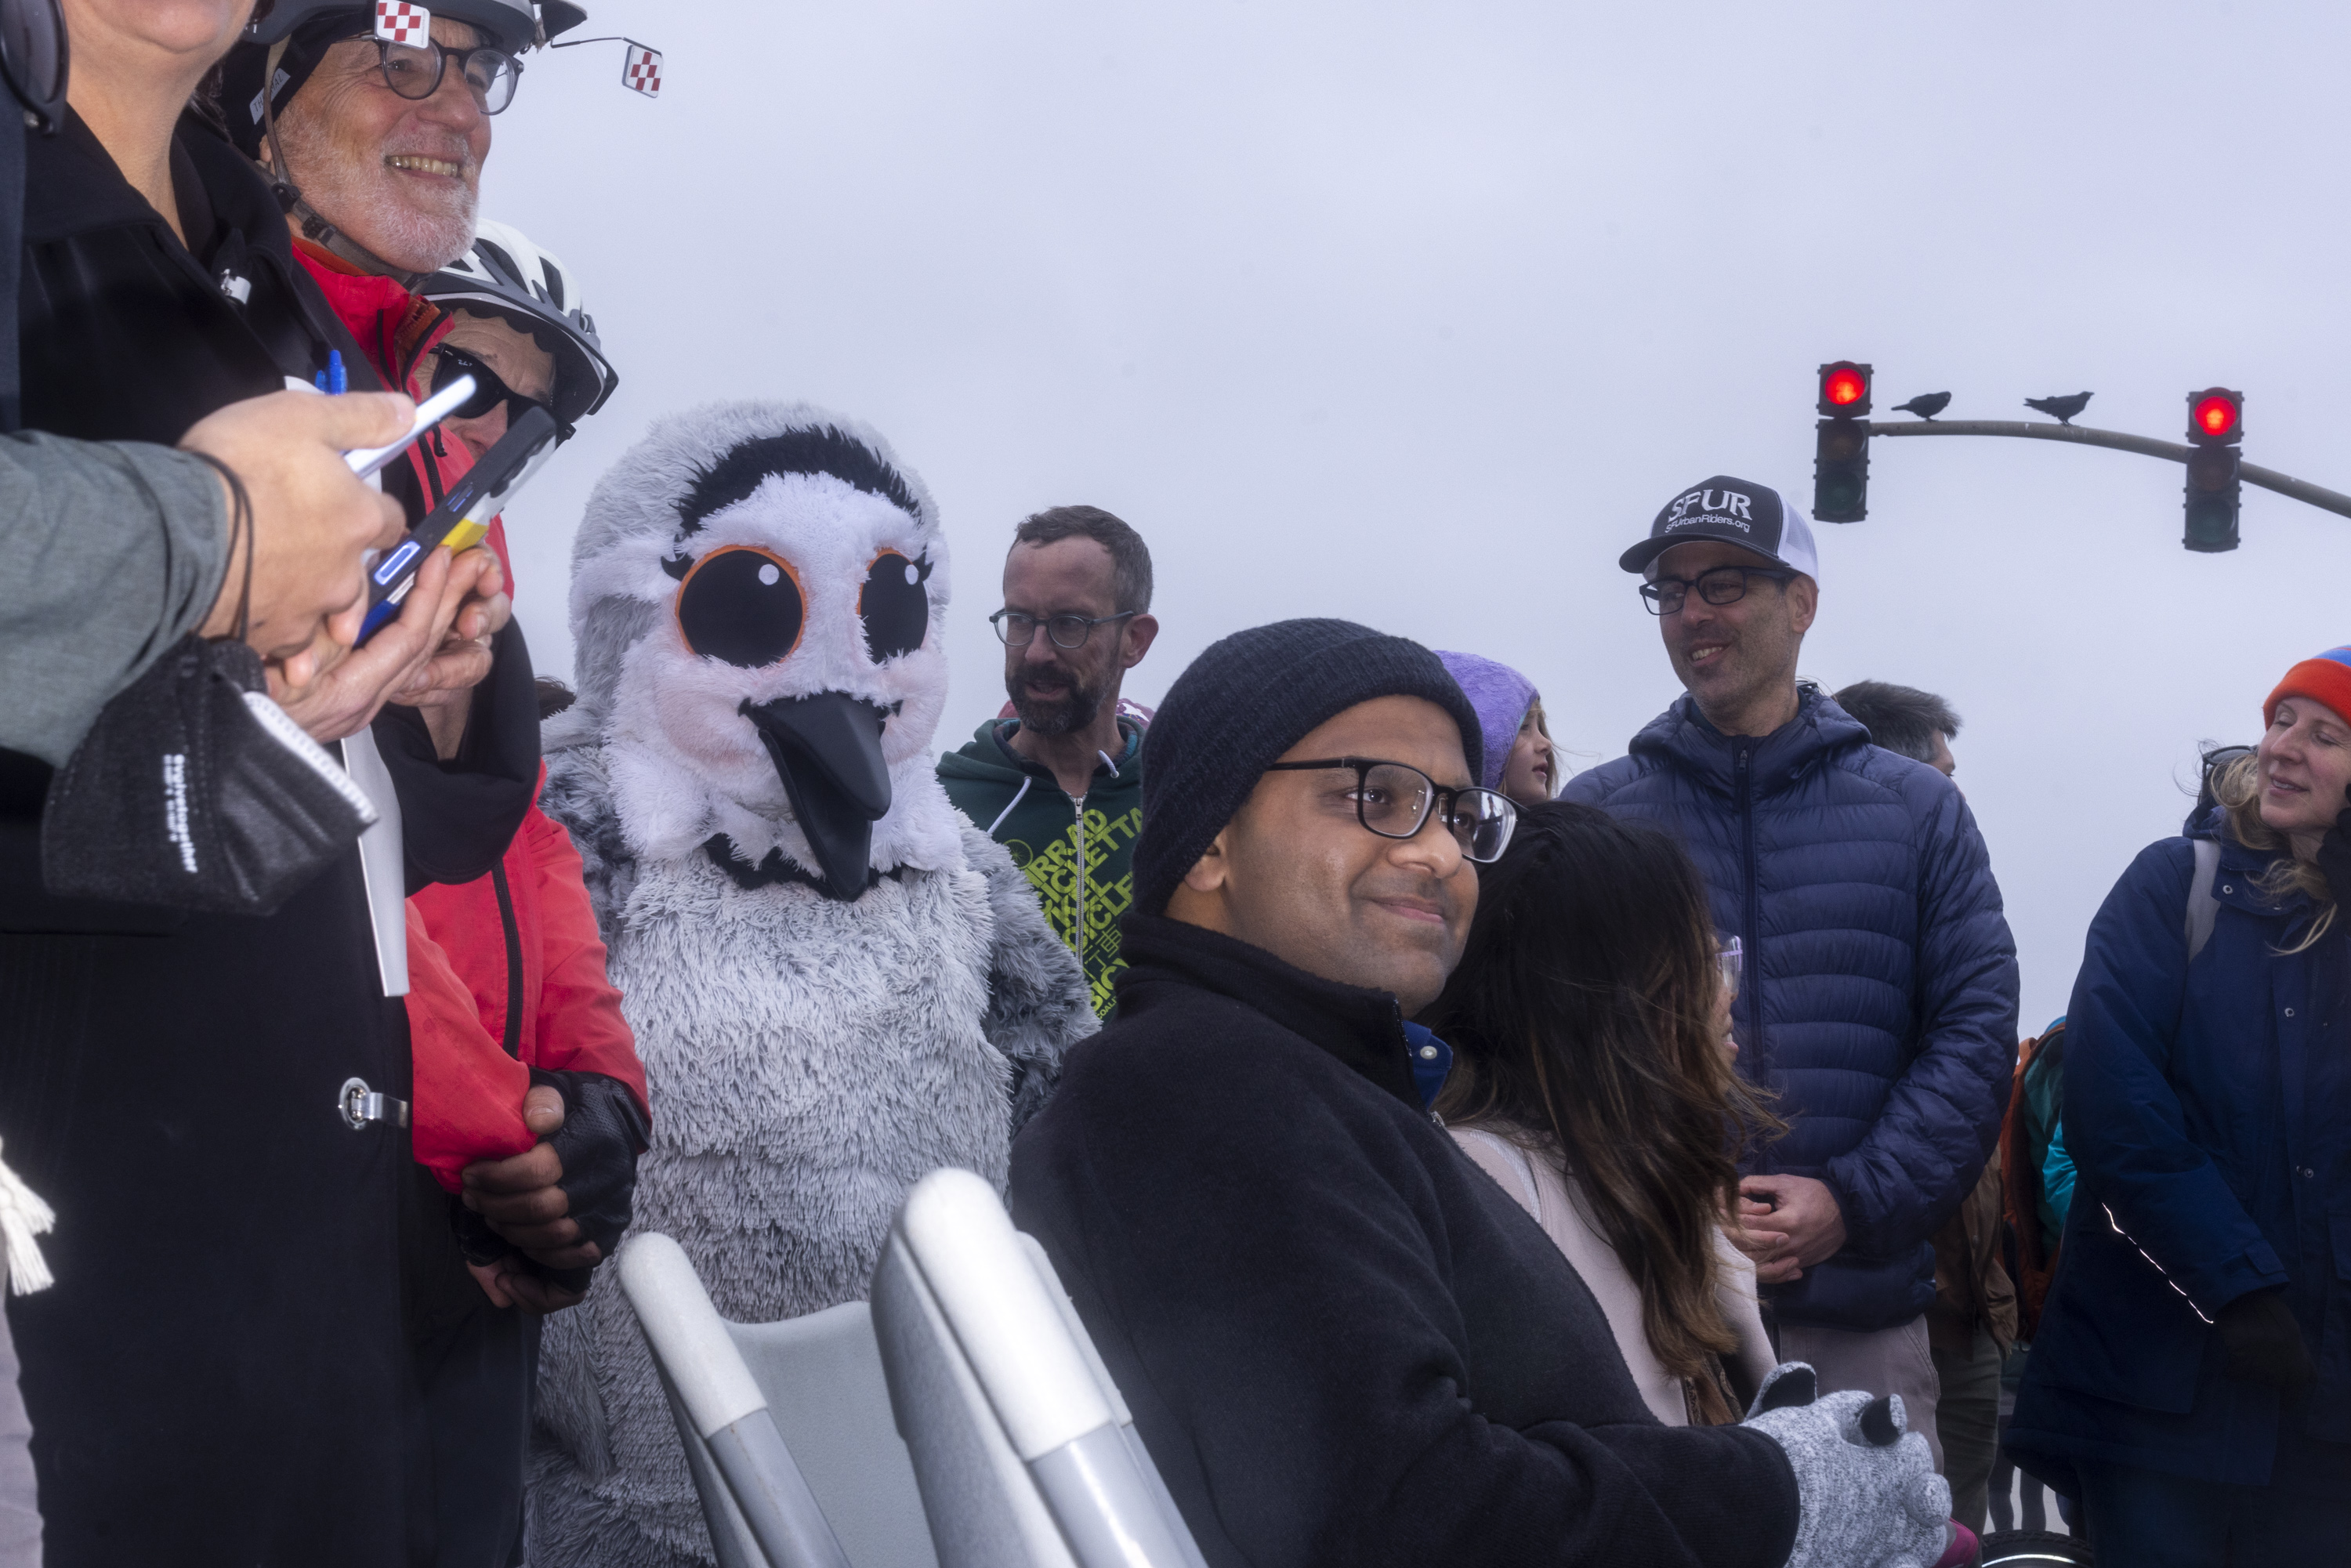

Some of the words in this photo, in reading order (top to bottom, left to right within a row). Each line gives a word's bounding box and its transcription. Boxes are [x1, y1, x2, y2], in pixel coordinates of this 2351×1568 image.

[1668, 488, 1753, 523] SFUR
[1665, 513, 1751, 534] SFUrbanRiders.org
[1061, 871, 1133, 953] CICLE
